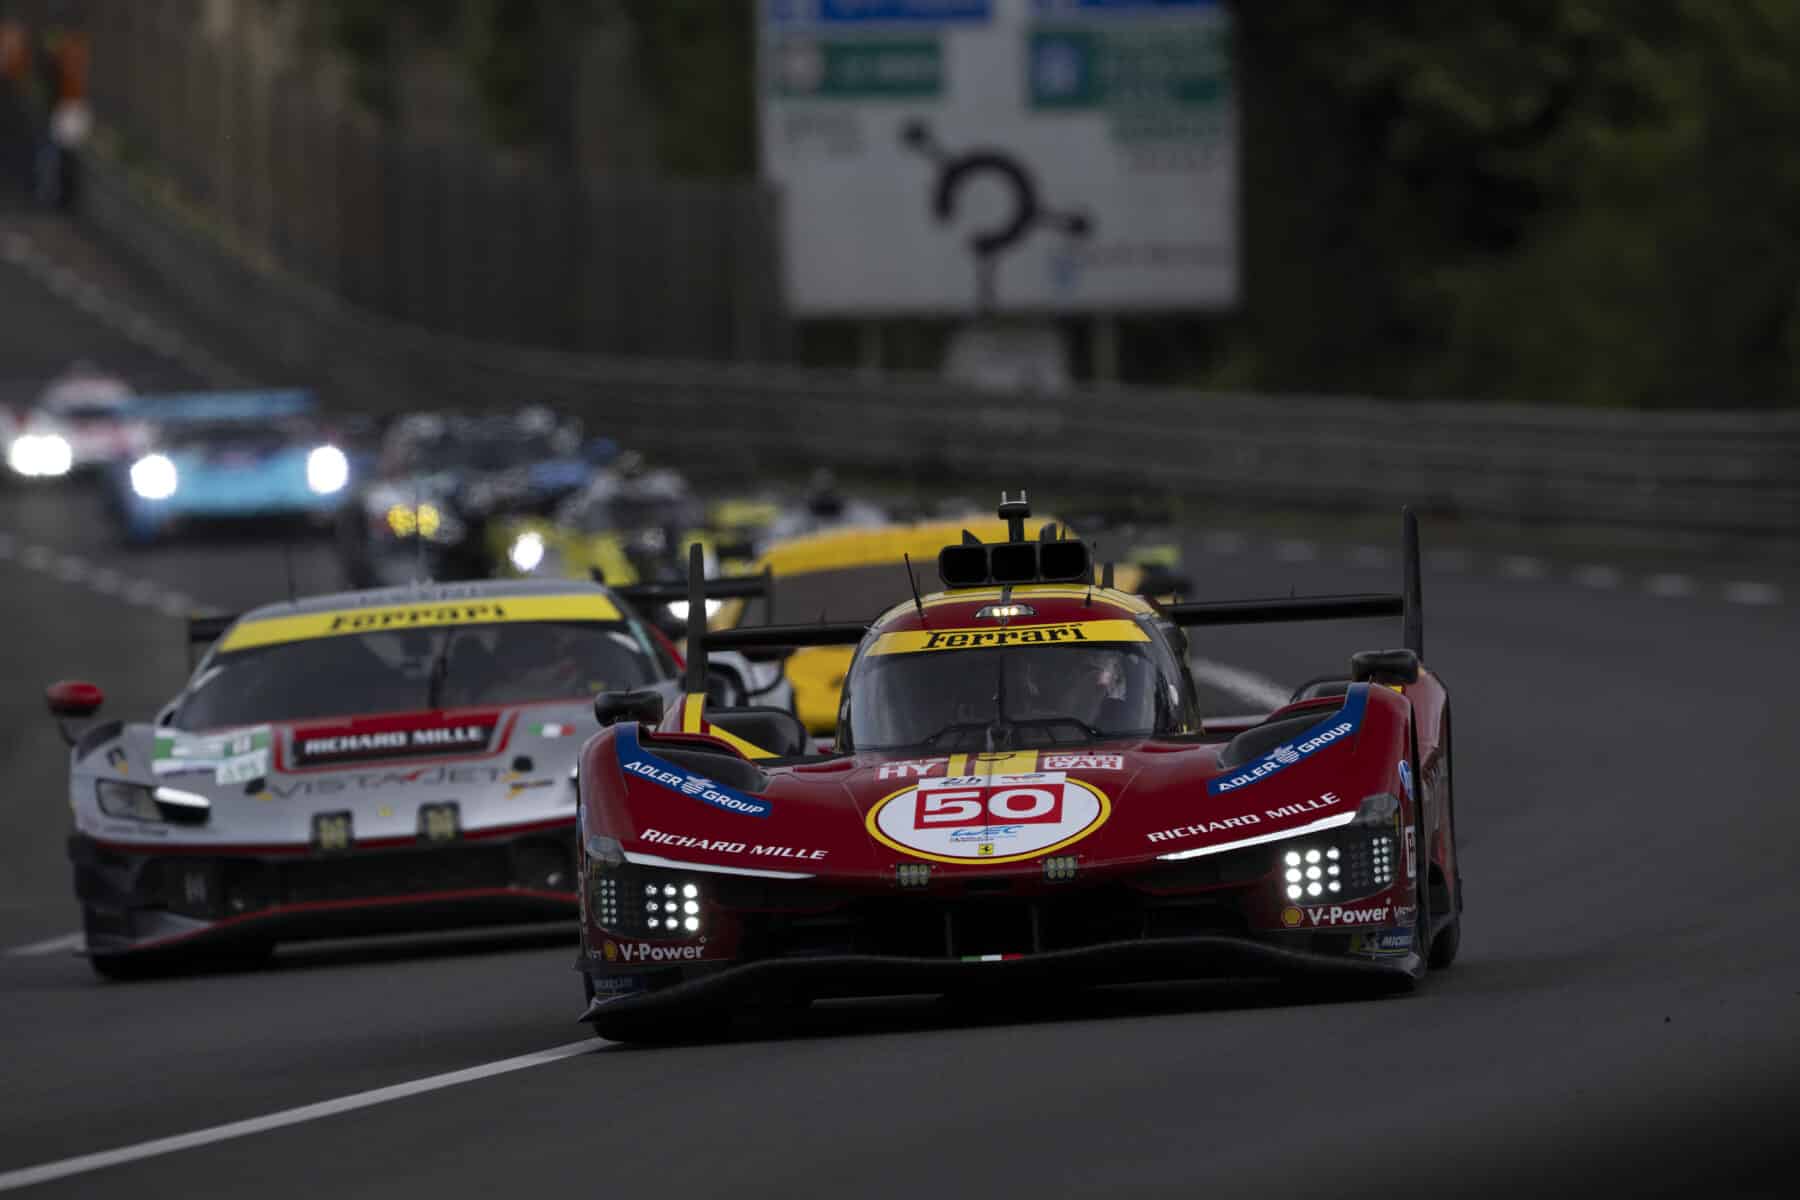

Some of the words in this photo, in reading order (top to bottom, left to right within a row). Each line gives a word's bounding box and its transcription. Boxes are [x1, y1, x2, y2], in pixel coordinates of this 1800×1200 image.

[331, 605, 505, 631] Ferrari
[920, 623, 1088, 649] Ferrari
[304, 730, 406, 753] RICHARD
[411, 724, 482, 744] MILLE
[1048, 759, 1118, 768] CAR
[1217, 761, 1281, 792] ADLER
[1296, 722, 1353, 753] GROUP
[623, 760, 682, 788] ADLER
[701, 788, 766, 814] GROUP
[921, 787, 1056, 823] 50
[1145, 813, 1262, 843] RICHARD
[1264, 791, 1342, 820] MILLE
[639, 828, 747, 854] RICHARD
[749, 844, 830, 860] MILLE
[1307, 905, 1389, 926] V-Power
[619, 943, 705, 961] V-Power
